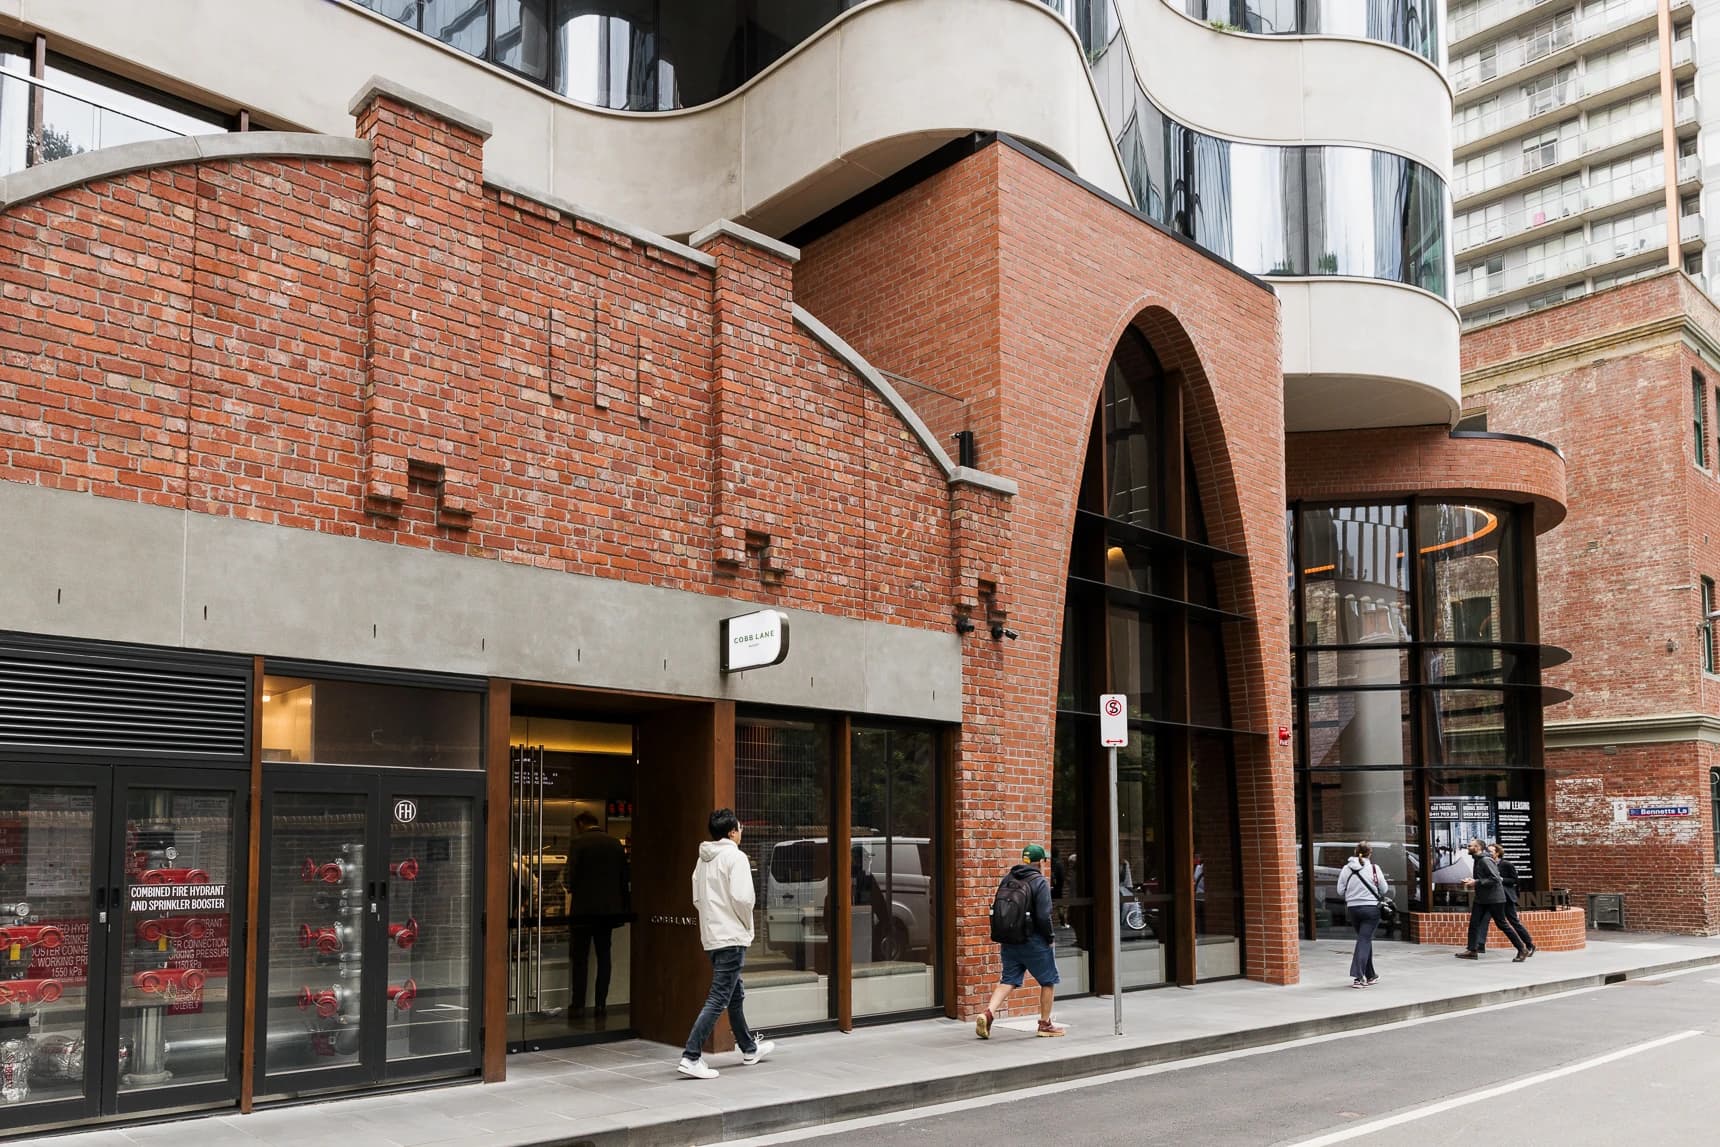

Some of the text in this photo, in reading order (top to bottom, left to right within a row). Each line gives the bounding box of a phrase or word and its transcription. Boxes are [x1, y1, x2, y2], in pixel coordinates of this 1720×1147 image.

[734, 630, 775, 644] COBB LANE
[399, 803, 412, 819] FH
[1640, 807, 1676, 815] Bennetts
[130, 885, 225, 898] COMBINED FIRE HYDRANT
[130, 898, 225, 912] AND SPRINKLER BOOSTER
[37, 956, 74, 967] WORKING
